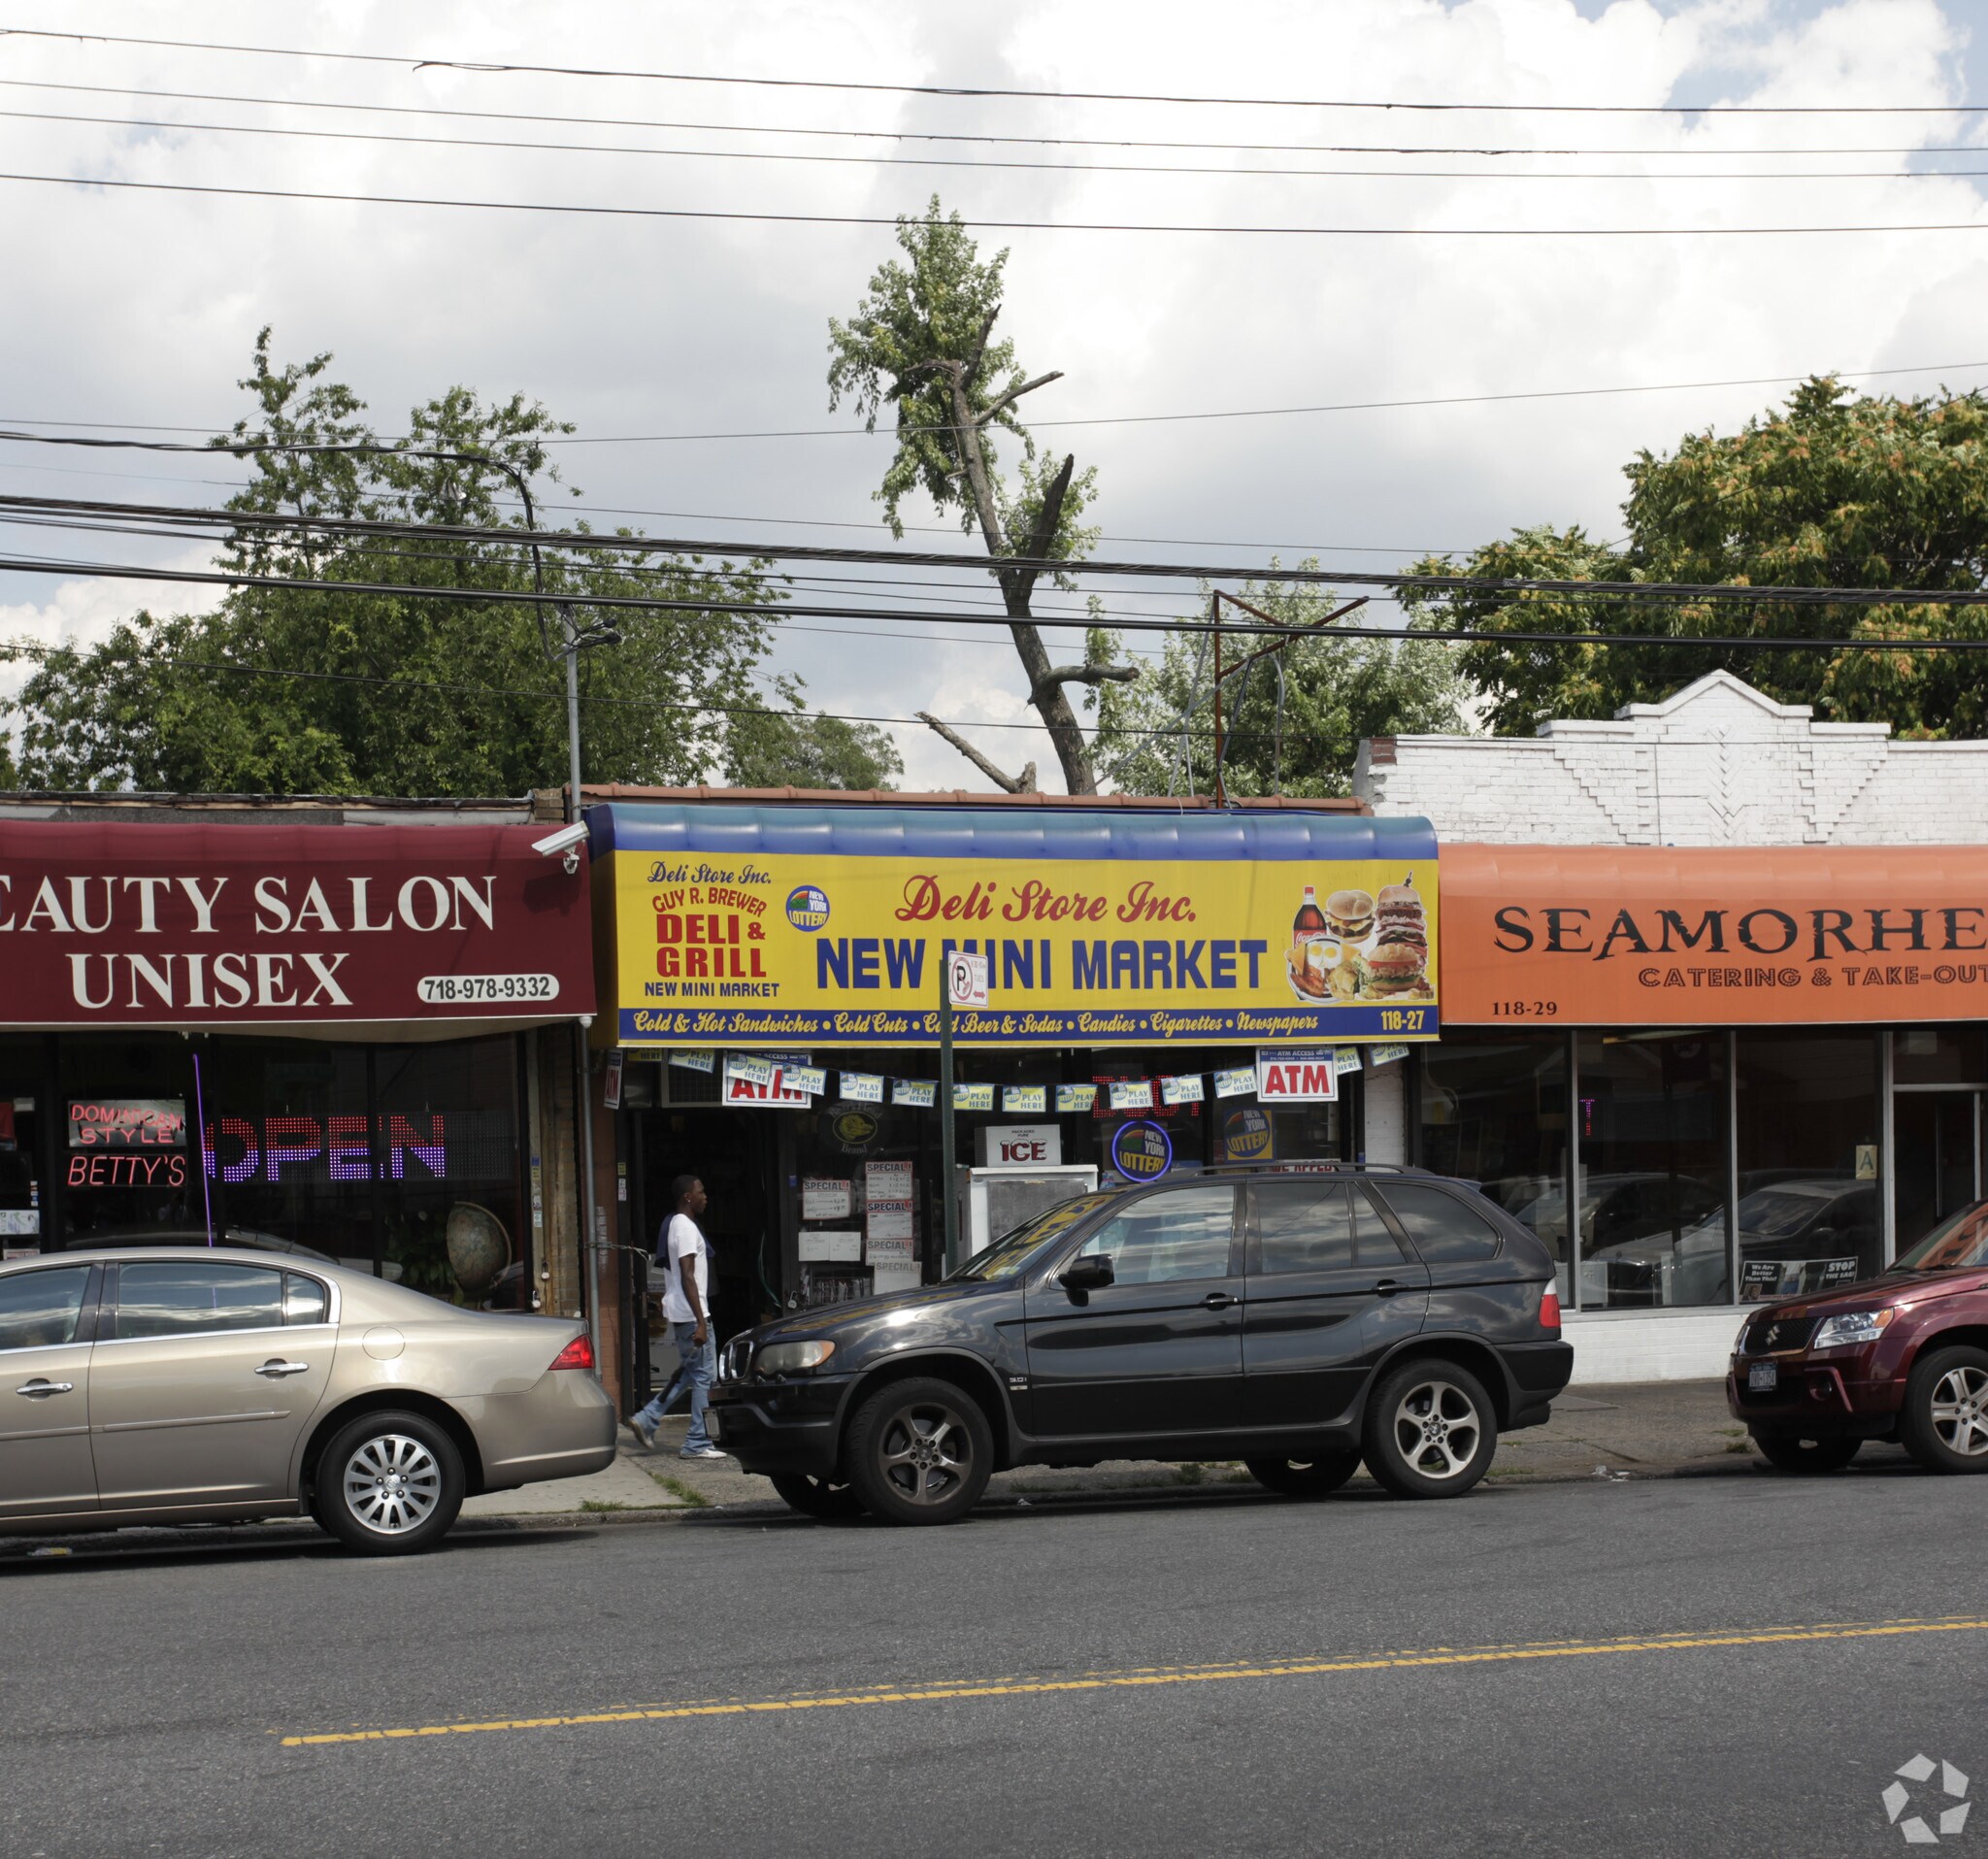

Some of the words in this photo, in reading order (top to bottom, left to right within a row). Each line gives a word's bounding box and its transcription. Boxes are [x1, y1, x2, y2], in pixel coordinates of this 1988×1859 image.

[647, 861, 688, 884] Deli
[691, 863, 735, 884] Store
[738, 864, 772, 884] Inc.
[253, 876, 497, 934] SALON
[651, 888, 684, 913] GUY
[690, 888, 705, 906] R.
[708, 887, 767, 917] BREWER
[809, 890, 824, 901] NEW
[895, 875, 997, 921] Deli
[1003, 880, 1108, 922] Store
[1117, 880, 1196, 922] Inc.
[810, 899, 827, 913] YORK
[656, 913, 740, 944] DELI
[747, 921, 766, 941] &
[789, 911, 827, 926] LOTTERY
[1493, 906, 1988, 962] SEAMORHE
[656, 946, 767, 978] GRILL
[816, 938, 926, 989] NEW
[1073, 940, 1267, 989] MARKET
[65, 952, 353, 1010] UNISEX
[1639, 967, 1802, 987] CATERING
[1811, 968, 1832, 986] &
[424, 977, 550, 1001] 718-978-9332
[646, 982, 677, 997] NEW
[681, 982, 715, 997] MINI
[720, 982, 779, 997] MARKET
[1491, 1001, 1558, 1016] 118-29
[634, 1011, 673, 1032] Cold
[674, 1013, 690, 1033] &
[693, 1012, 726, 1032] Hot
[729, 1012, 818, 1033] Sandwiches
[834, 1012, 871, 1033] Cold
[872, 1012, 909, 1033] Cuts
[923, 1012, 960, 1033] Cod
[961, 1012, 998, 1033] Beer
[1001, 1014, 1016, 1034] &
[1019, 1013, 1063, 1034] Sodas
[1077, 1012, 1136, 1032] Candies
[1150, 1011, 1222, 1038] Cigarettes
[1237, 1011, 1318, 1036] Newspapers
[1380, 1011, 1424, 1030] 118-27
[687, 1058, 712, 1069] HERE
[1338, 1062, 1358, 1071] HERE
[745, 1072, 767, 1082] HERE
[1234, 1082, 1255, 1092] HERE
[1265, 1065, 1330, 1094] ATM
[799, 1083, 821, 1093] HERE
[1180, 1091, 1202, 1100] HERE
[910, 1095, 932, 1104] HERE
[71, 1105, 182, 1131] DOMINICAN
[1243, 1110, 1261, 1119] NEW
[1245, 1119, 1266, 1132] YORK
[81, 1127, 175, 1145] STYLE
[1145, 1130, 1162, 1145] NEW
[1226, 1130, 1269, 1152] LOTTERY
[202, 1115, 446, 1181] OPEN
[1000, 1138, 1047, 1162] ICE
[1144, 1141, 1165, 1156] YORK
[68, 1155, 186, 1186] BETTY'S
[1119, 1151, 1165, 1172] LOTTERY
[1859, 1150, 1873, 1171] A
[1828, 1261, 1855, 1273] STOP
